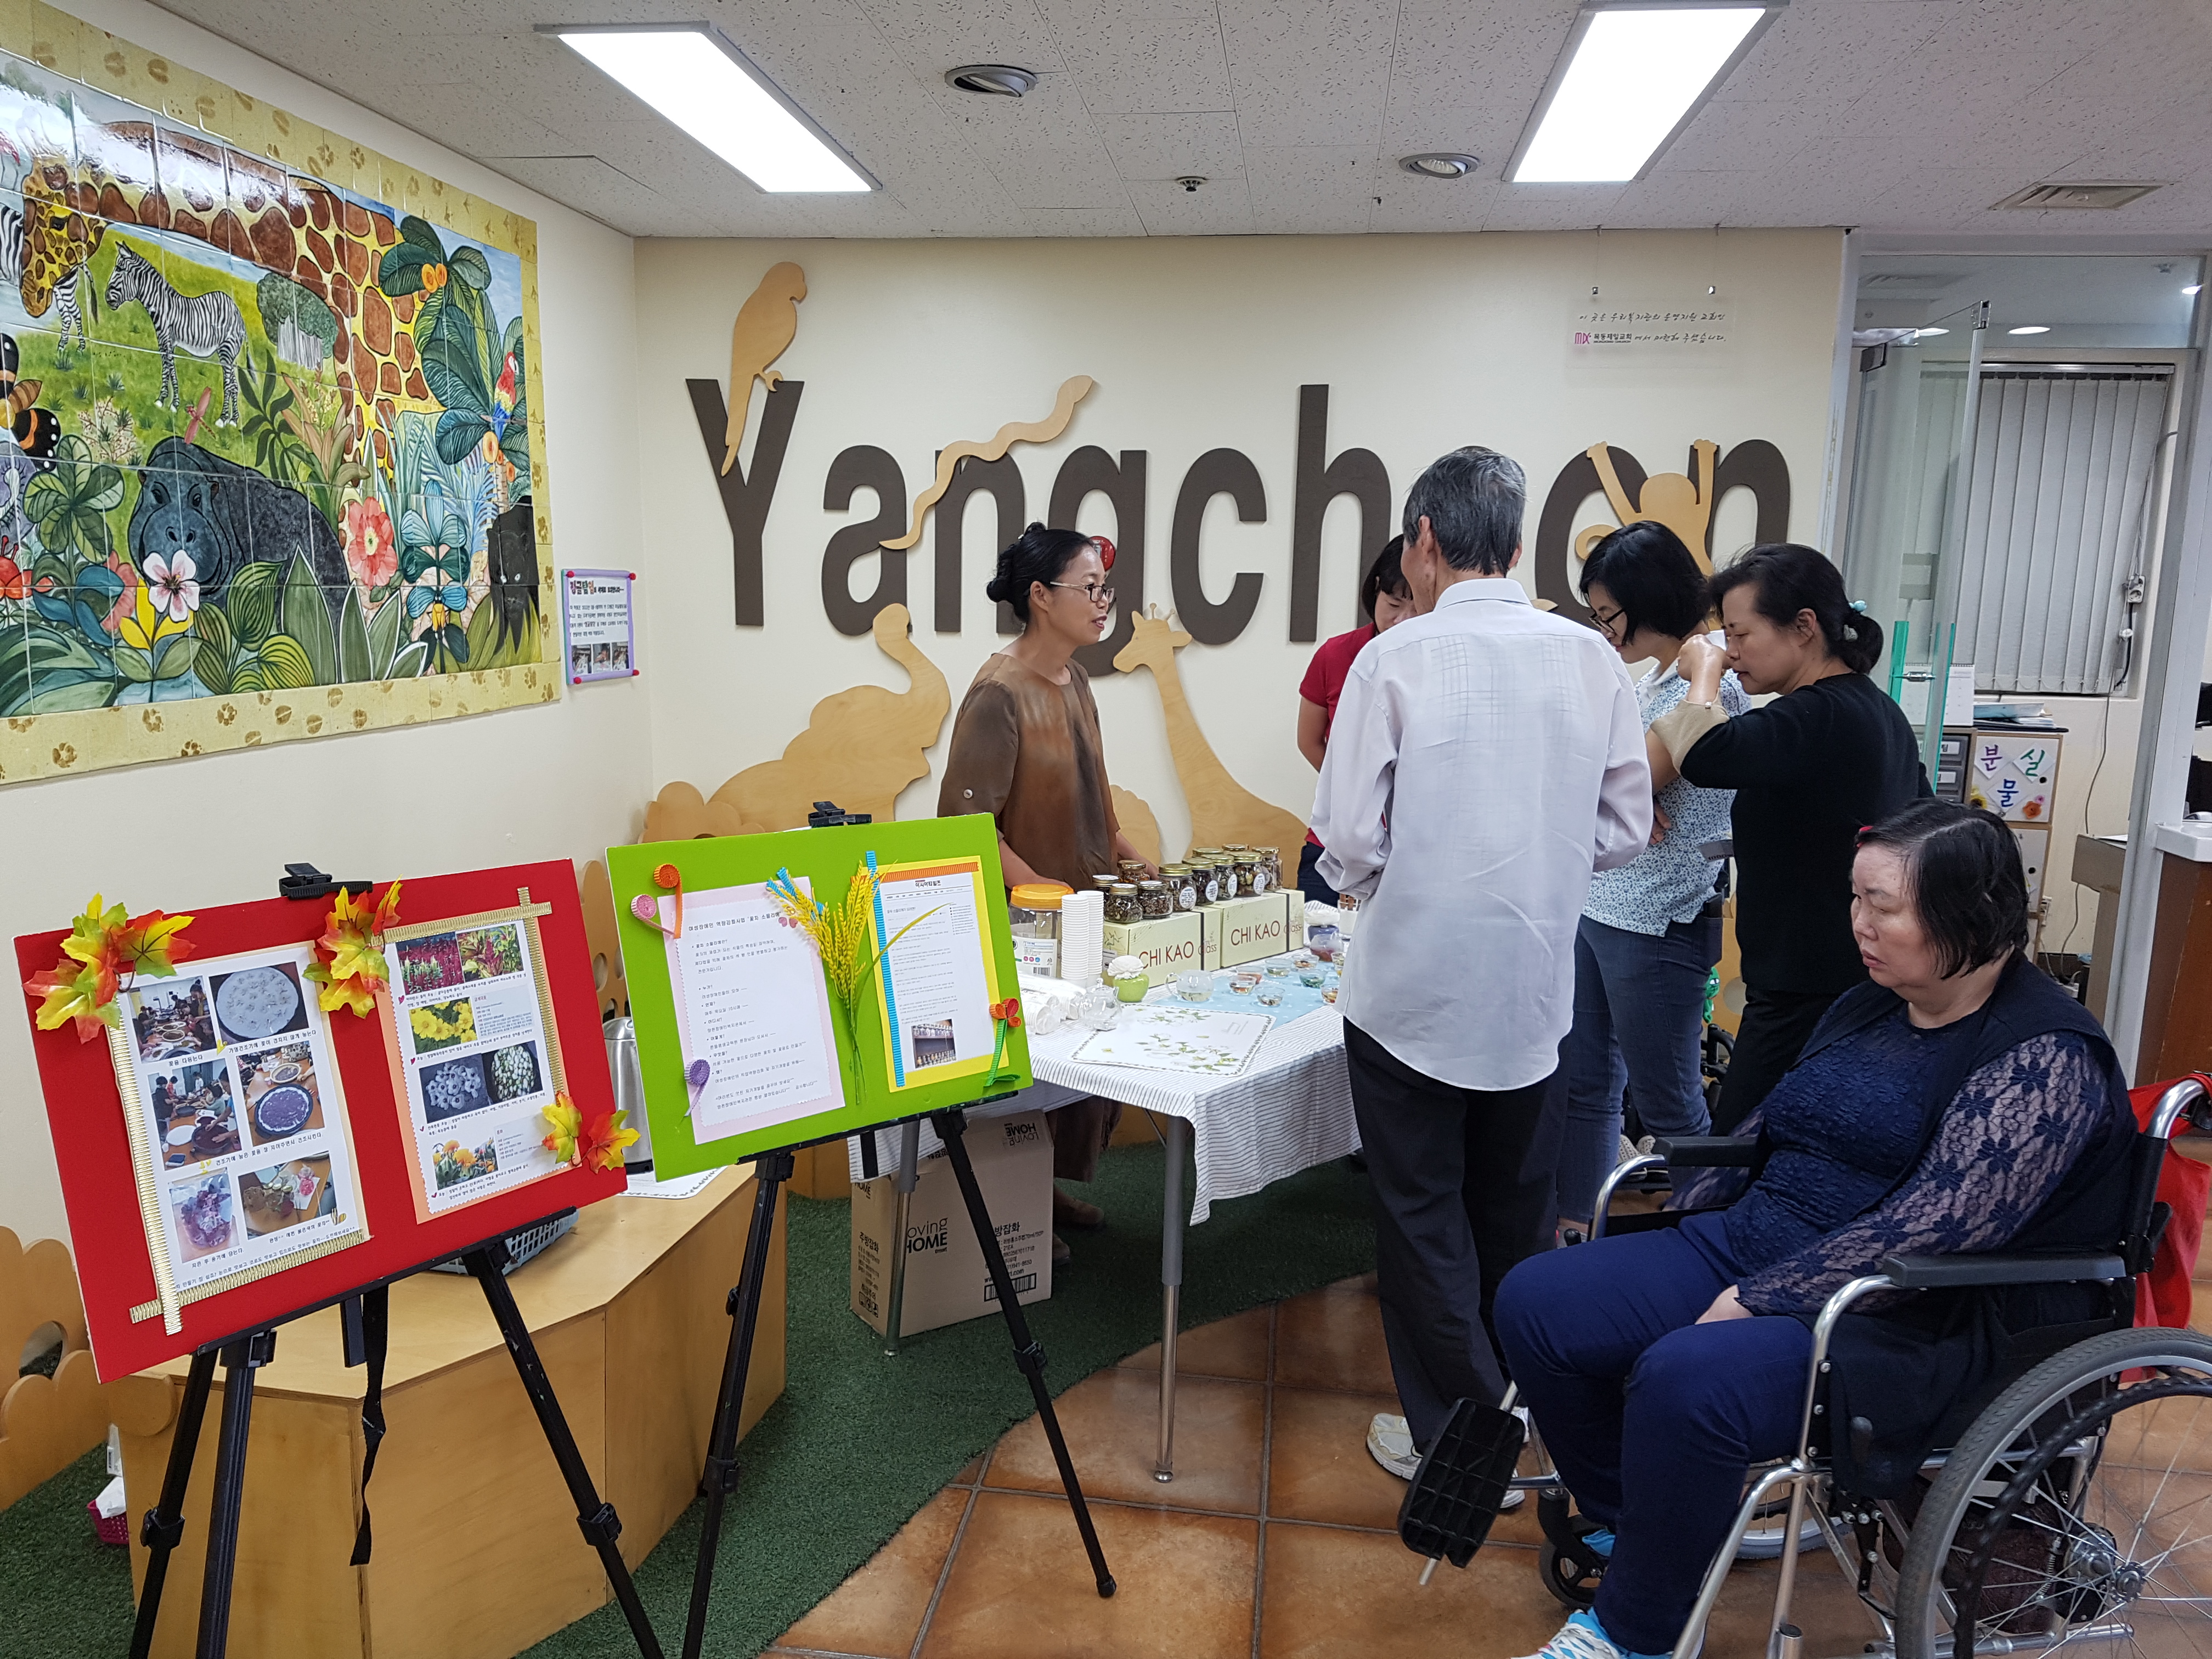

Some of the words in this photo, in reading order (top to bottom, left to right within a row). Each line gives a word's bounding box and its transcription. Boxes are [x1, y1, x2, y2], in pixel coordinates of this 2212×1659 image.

[1590, 312, 1606, 323] 곳은
[1663, 312, 1697, 321] 운영지원
[1231, 926, 1251, 946] CHI
[1255, 920, 1280, 941] KAO
[1138, 947, 1161, 969] CHI
[1166, 941, 1194, 963] KAO
[1005, 1123, 1036, 1137] HOME
[216, 1156, 236, 1166] 건조기에
[907, 1217, 948, 1239] oving
